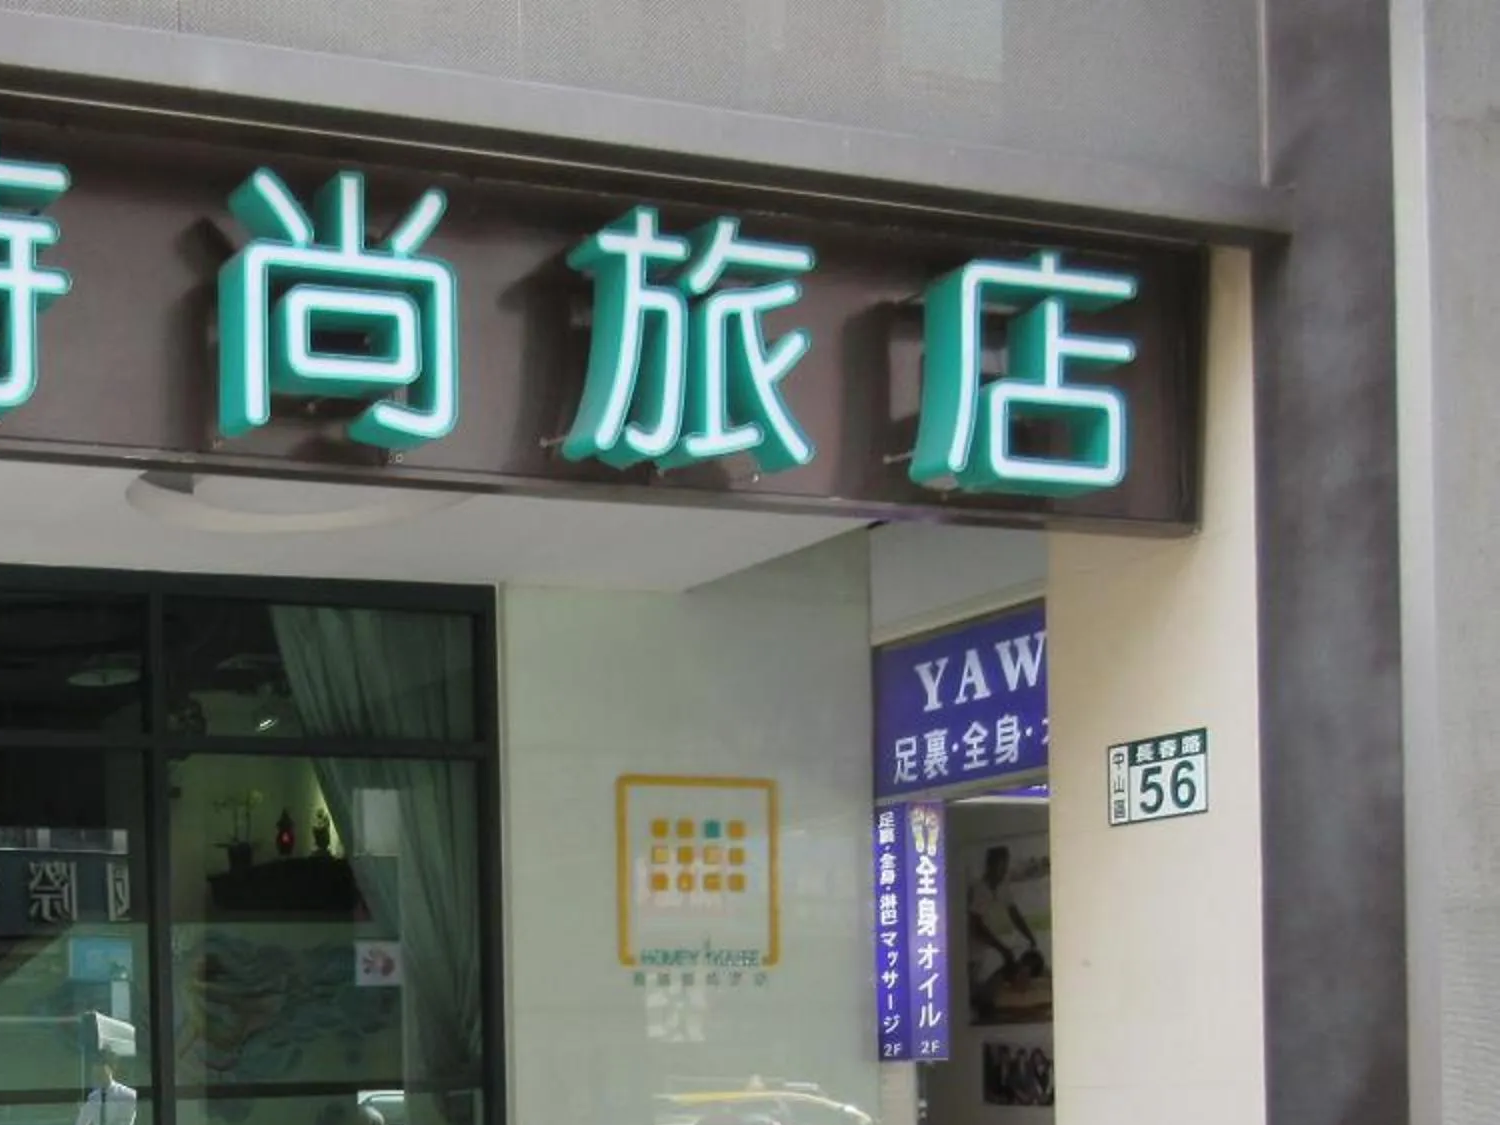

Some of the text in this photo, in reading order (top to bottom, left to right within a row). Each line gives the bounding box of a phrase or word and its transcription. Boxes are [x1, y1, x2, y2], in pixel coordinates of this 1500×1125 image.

[893, 714, 1048, 785] 足裏・全身・
[1140, 760, 1196, 814] 56
[915, 855, 942, 1028] 全身オイル
[883, 1043, 902, 1057] 2F
[920, 1040, 940, 1054] 2F
